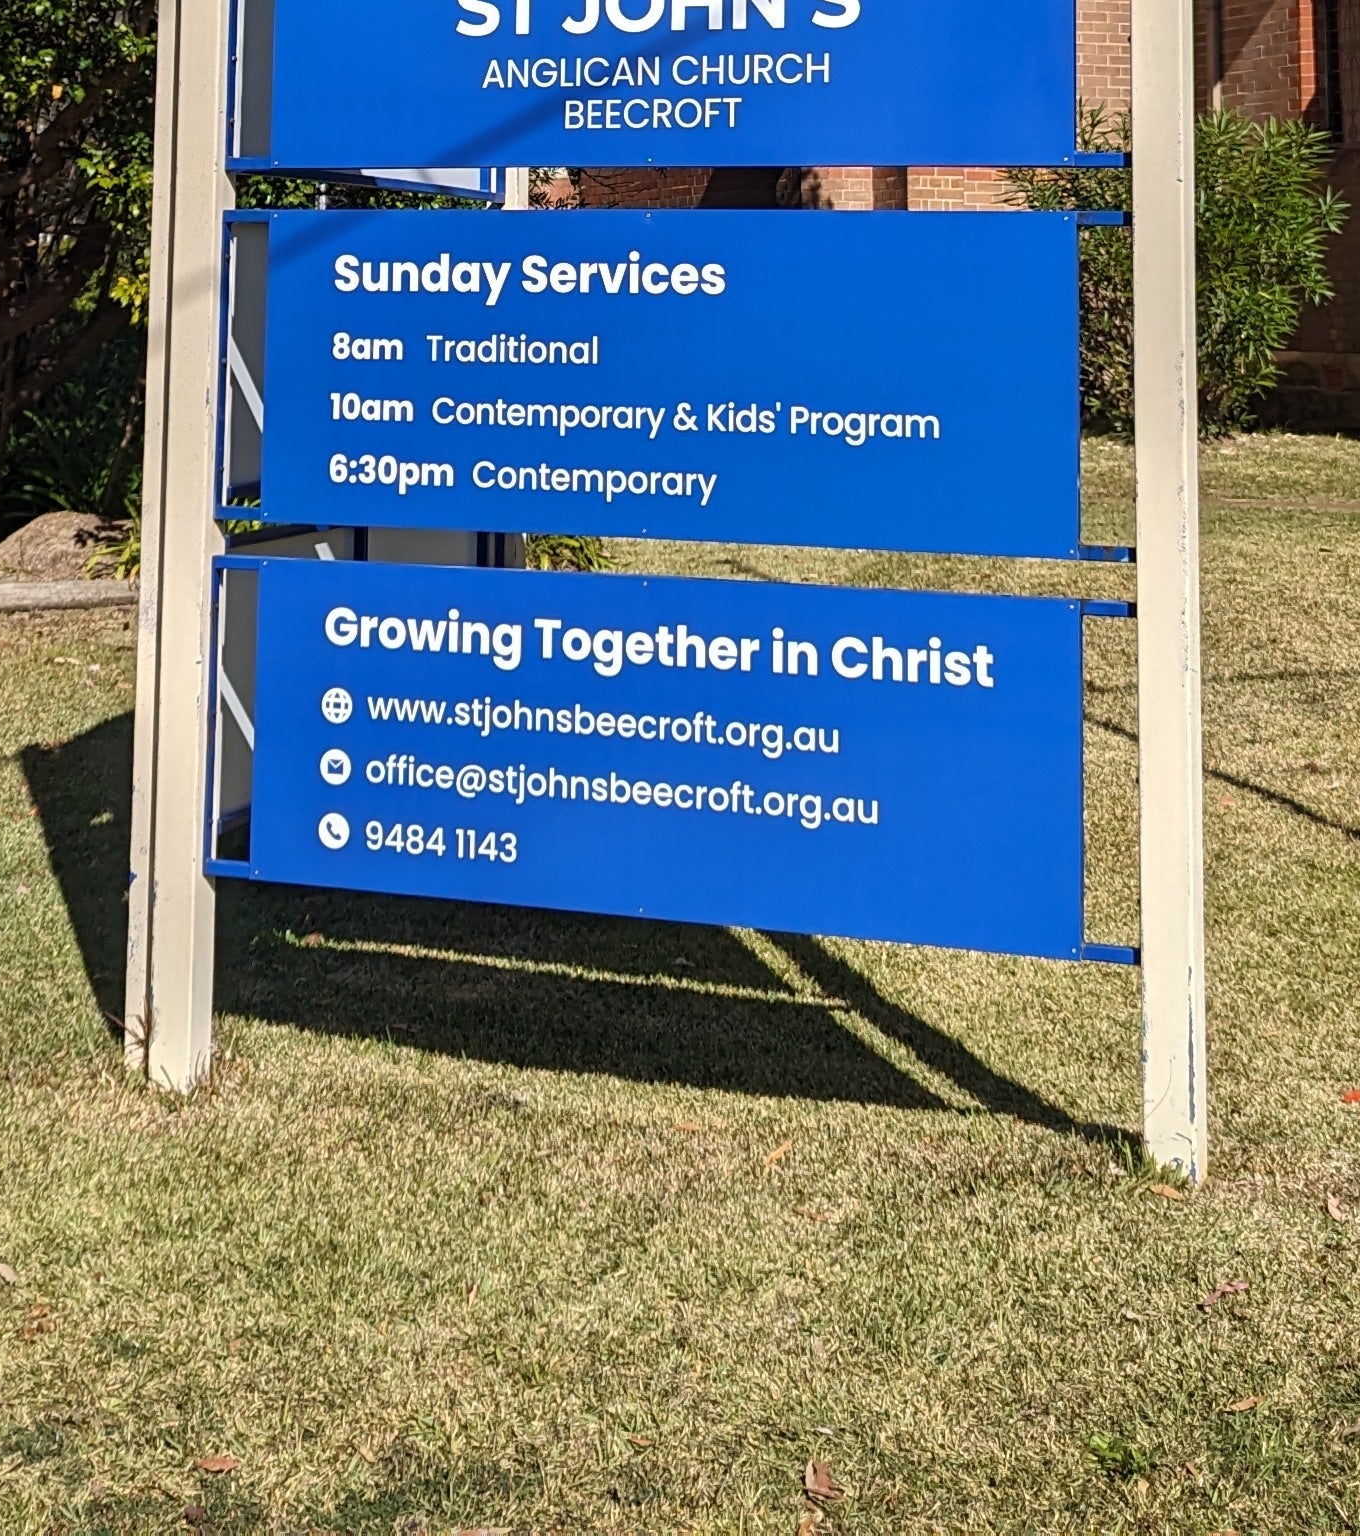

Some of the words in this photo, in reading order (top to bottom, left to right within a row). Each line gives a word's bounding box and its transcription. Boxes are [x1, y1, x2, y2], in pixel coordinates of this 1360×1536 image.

[481, 55, 661, 89] ANGLICAN
[672, 52, 831, 86] CHURCH
[564, 97, 743, 129] BEECROFT
[334, 253, 512, 306] Sunday
[521, 250, 726, 295] Services
[332, 332, 404, 362] 8am
[426, 333, 599, 365] Traditional
[329, 392, 414, 422] 10am
[431, 397, 666, 439] Contemporary
[673, 402, 699, 431] &
[707, 401, 782, 434] Kids'
[790, 406, 941, 447] Program
[329, 453, 455, 495] 6:30pm
[472, 460, 718, 506] Contemporary
[324, 606, 522, 671] Growing
[533, 618, 760, 677] Together
[772, 627, 818, 676] in
[831, 636, 995, 688] Christ
[367, 695, 840, 759] www.stjohnsbeecroft.org.au
[365, 753, 879, 830] office@stjohnsbeecroft.org.au
[365, 820, 447, 857] 9484
[455, 828, 518, 864] 1143
